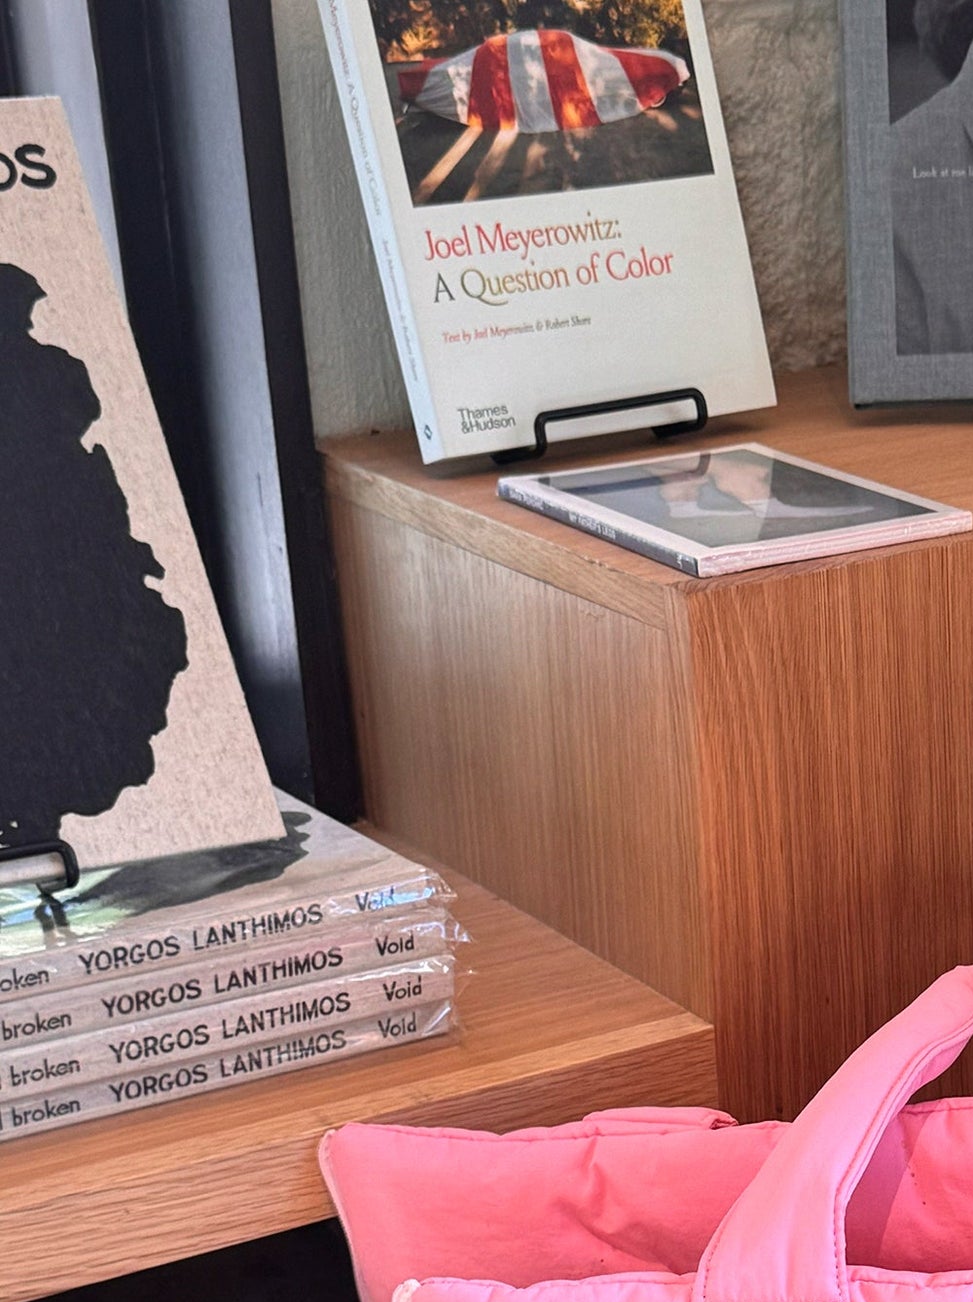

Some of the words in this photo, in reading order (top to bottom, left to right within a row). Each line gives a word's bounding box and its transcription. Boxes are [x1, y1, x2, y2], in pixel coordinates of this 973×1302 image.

[424, 225, 473, 261] Joel
[475, 211, 622, 261] Meyerowitz:
[433, 272, 456, 303] A
[460, 260, 572, 307] Question
[576, 252, 600, 285] of
[605, 246, 675, 281] Color
[457, 405, 509, 420] Thames
[461, 416, 516, 434] &Hudson
[78, 936, 182, 976] YORGOS
[192, 904, 325, 951] LANTHIMOS
[2, 1012, 72, 1041] broken
[101, 979, 202, 1018] YORGOS
[213, 948, 344, 994] LANTHIMOS
[108, 1024, 210, 1065] YORGOS
[222, 992, 352, 1039] LANTHIMOS
[383, 975, 423, 1002] Void
[12, 1099, 81, 1127] broken
[109, 1062, 208, 1103] YORGOS
[220, 1030, 348, 1078] LANTHIMOS
[378, 1013, 418, 1039] Void
